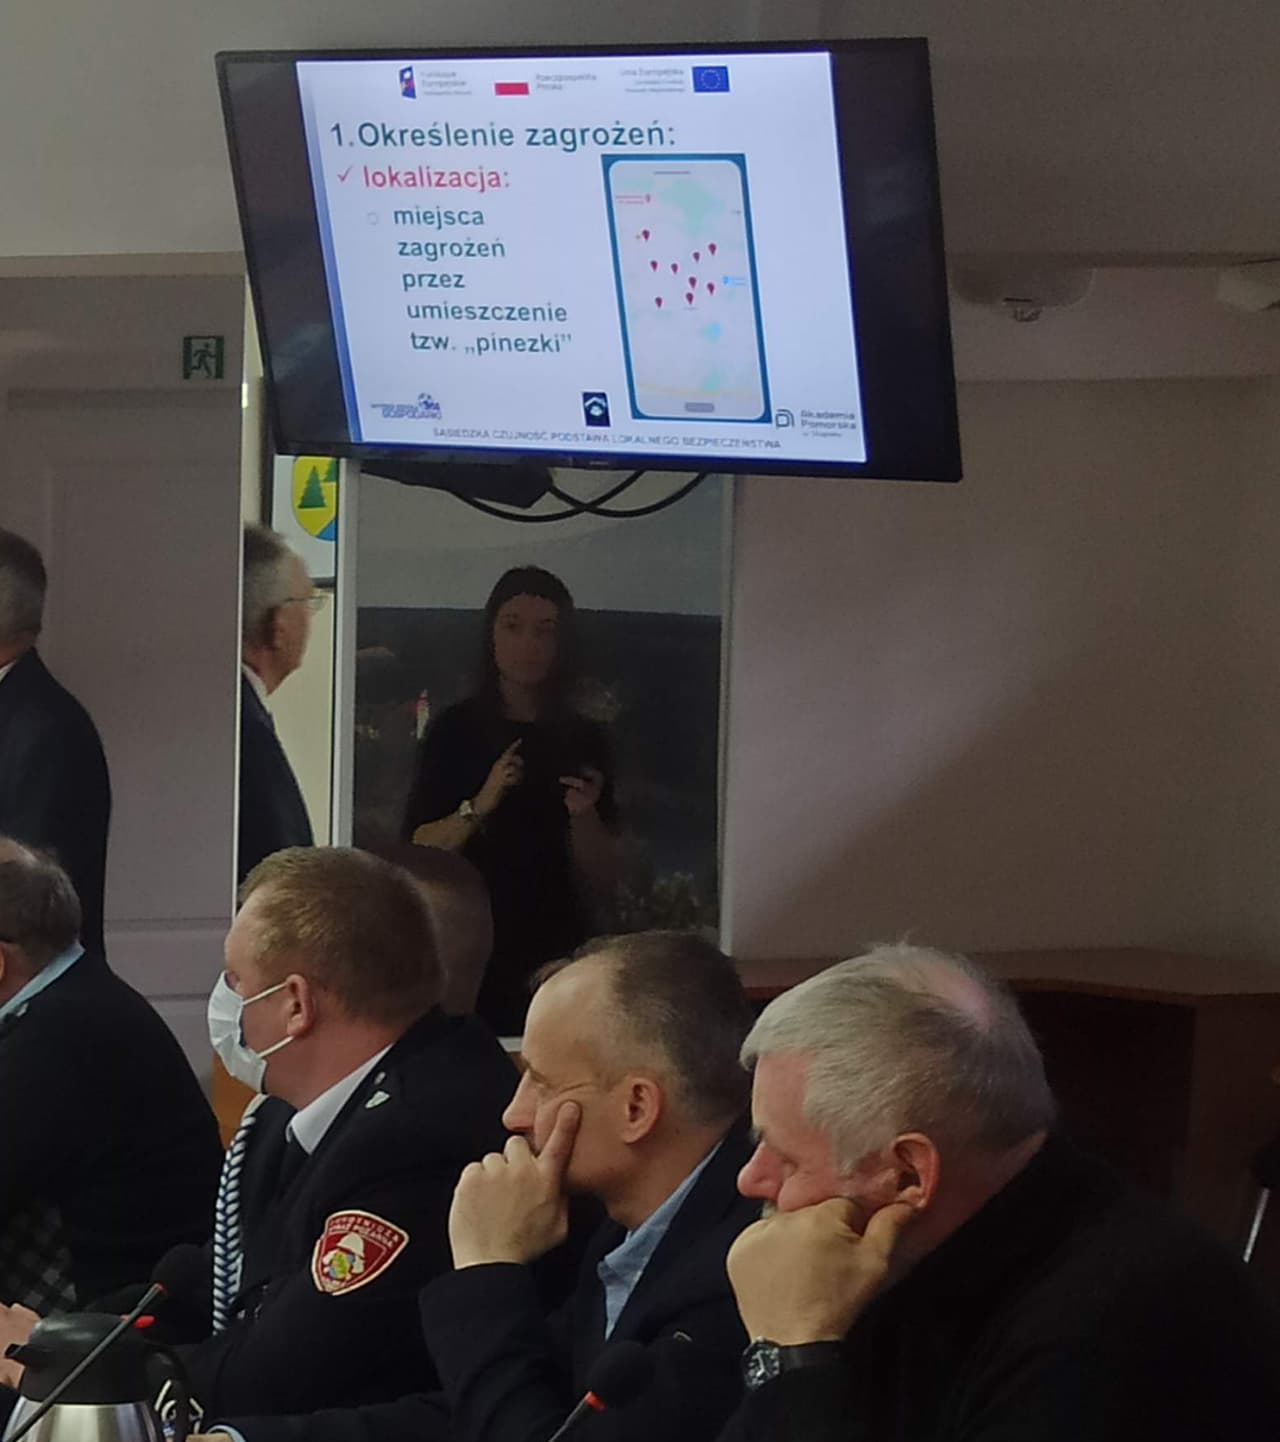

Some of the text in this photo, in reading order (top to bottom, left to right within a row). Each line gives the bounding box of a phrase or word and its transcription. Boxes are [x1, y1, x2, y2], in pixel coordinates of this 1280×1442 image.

[525, 121, 676, 152] zagrożeń:
[363, 165, 510, 193] lokalizacja:
[393, 205, 485, 231] miejsca
[397, 238, 506, 262] zagrożeń
[402, 272, 466, 293] przez
[406, 301, 568, 323] umieszczenie
[410, 331, 457, 351] tzw.
